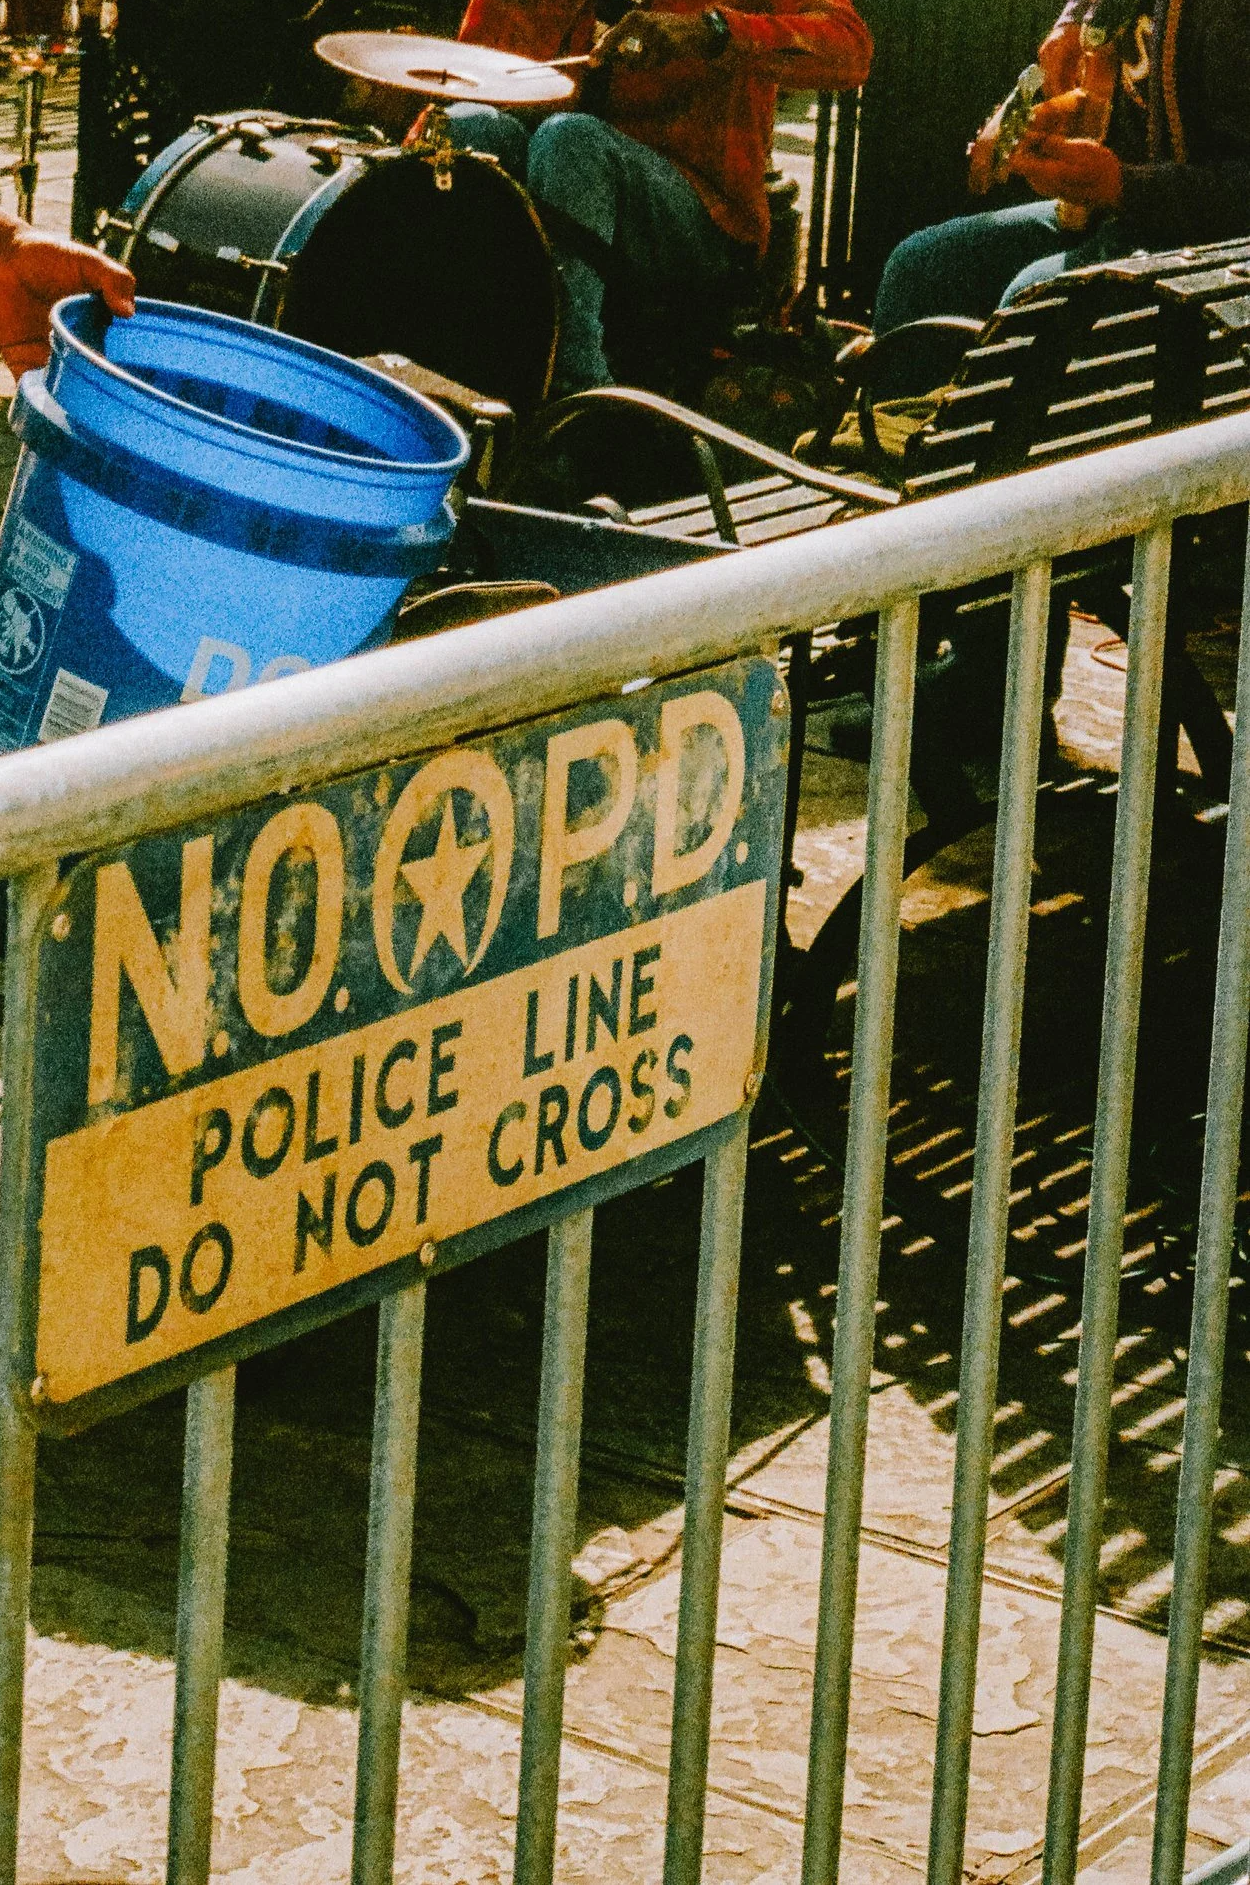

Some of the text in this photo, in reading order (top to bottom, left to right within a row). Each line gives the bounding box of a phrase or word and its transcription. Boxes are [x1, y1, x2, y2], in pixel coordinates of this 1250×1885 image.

[125, 1032, 695, 1345] DO NOT CROSS
[188, 942, 664, 1207] POLICE LINE
